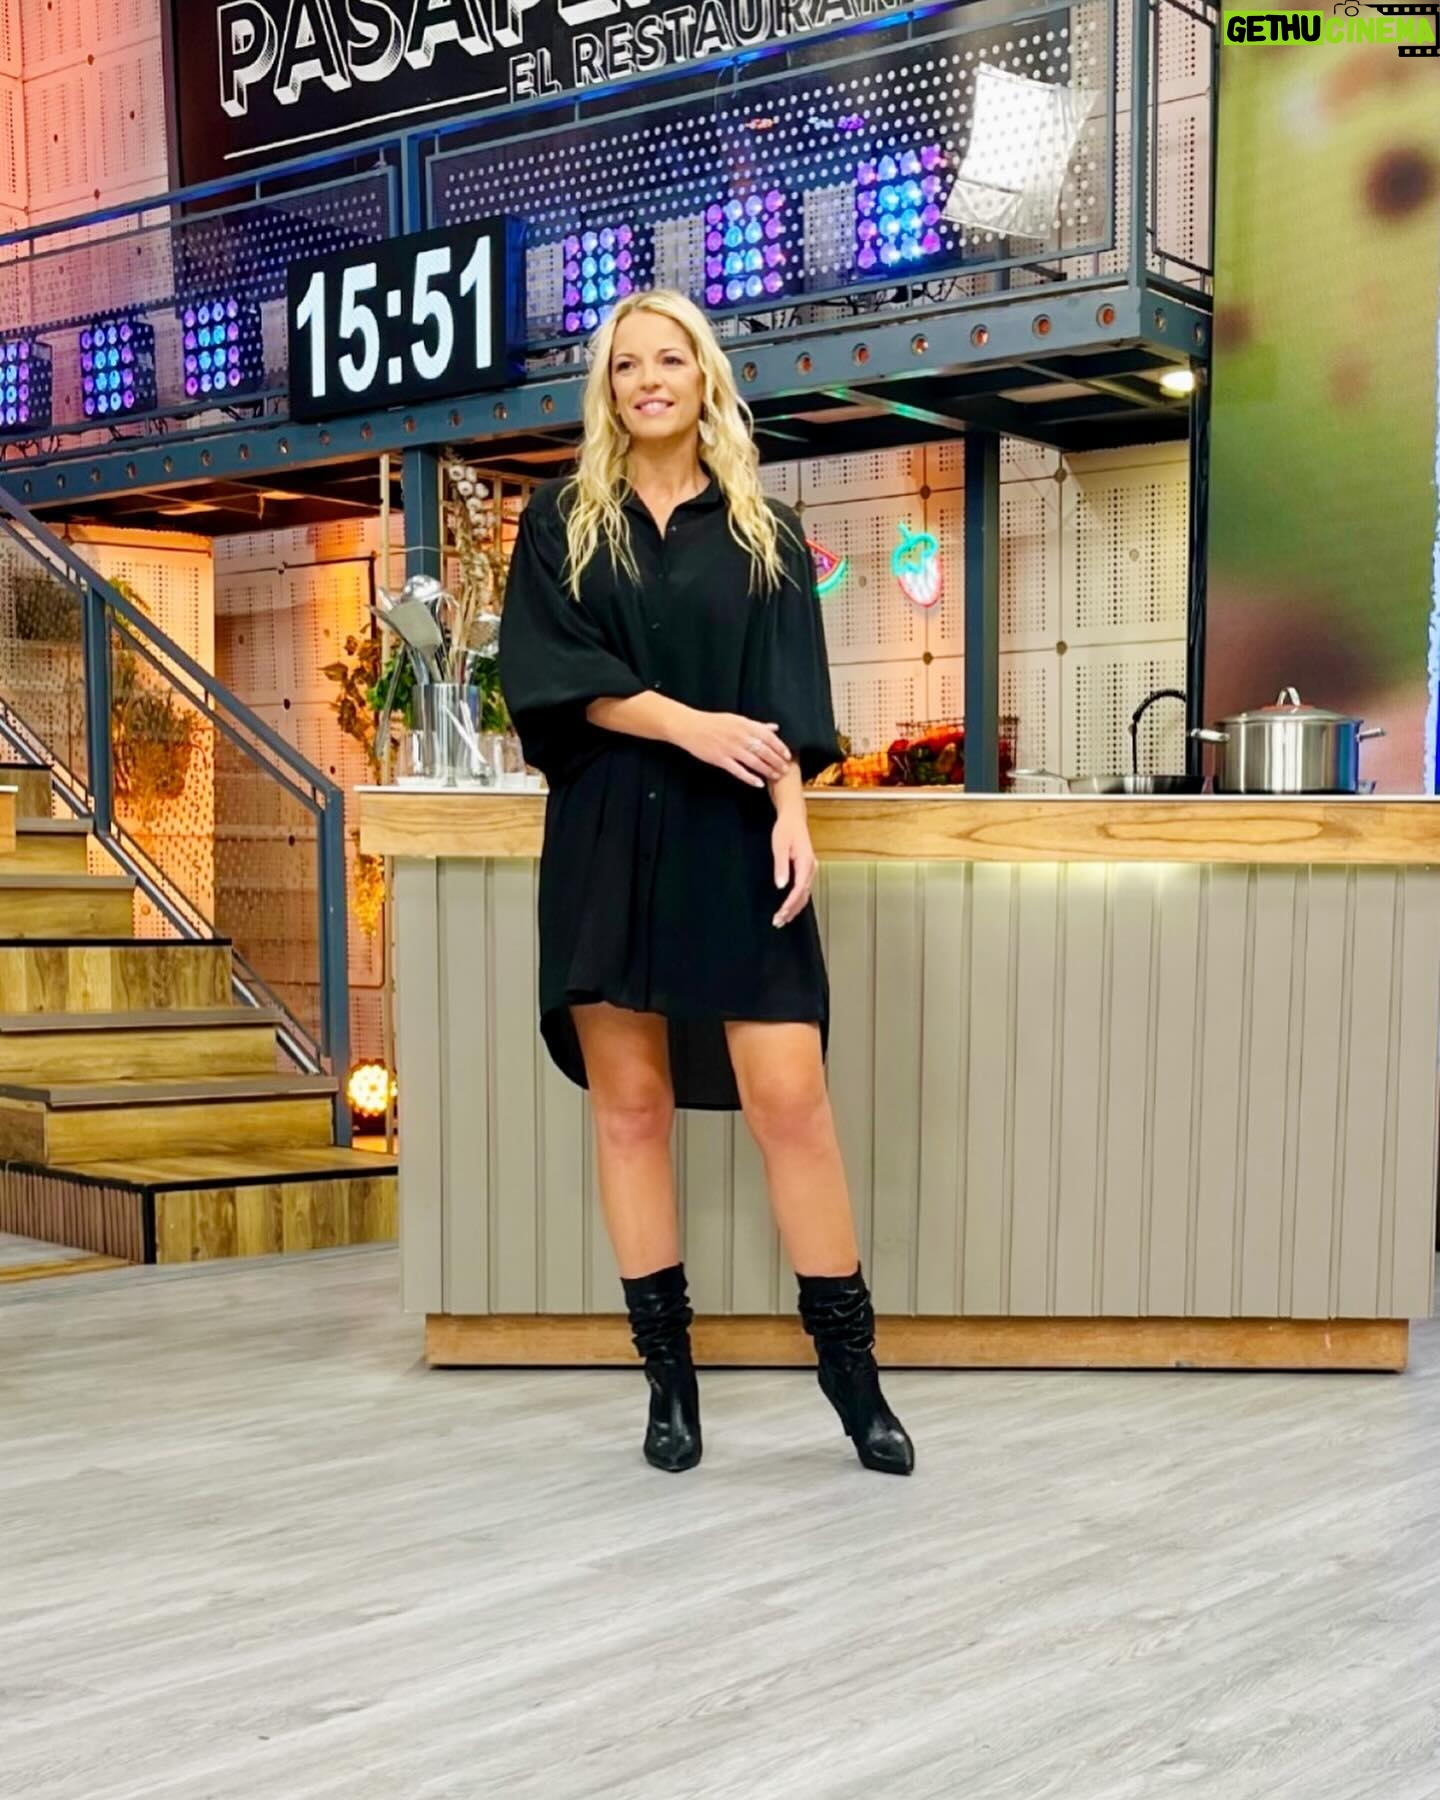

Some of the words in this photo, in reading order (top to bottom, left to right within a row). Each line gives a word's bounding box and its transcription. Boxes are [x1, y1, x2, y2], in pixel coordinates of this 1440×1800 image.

[217, 0, 650, 117] PASA
[509, 48, 562, 103] EL
[296, 235, 492, 398] 15:51
